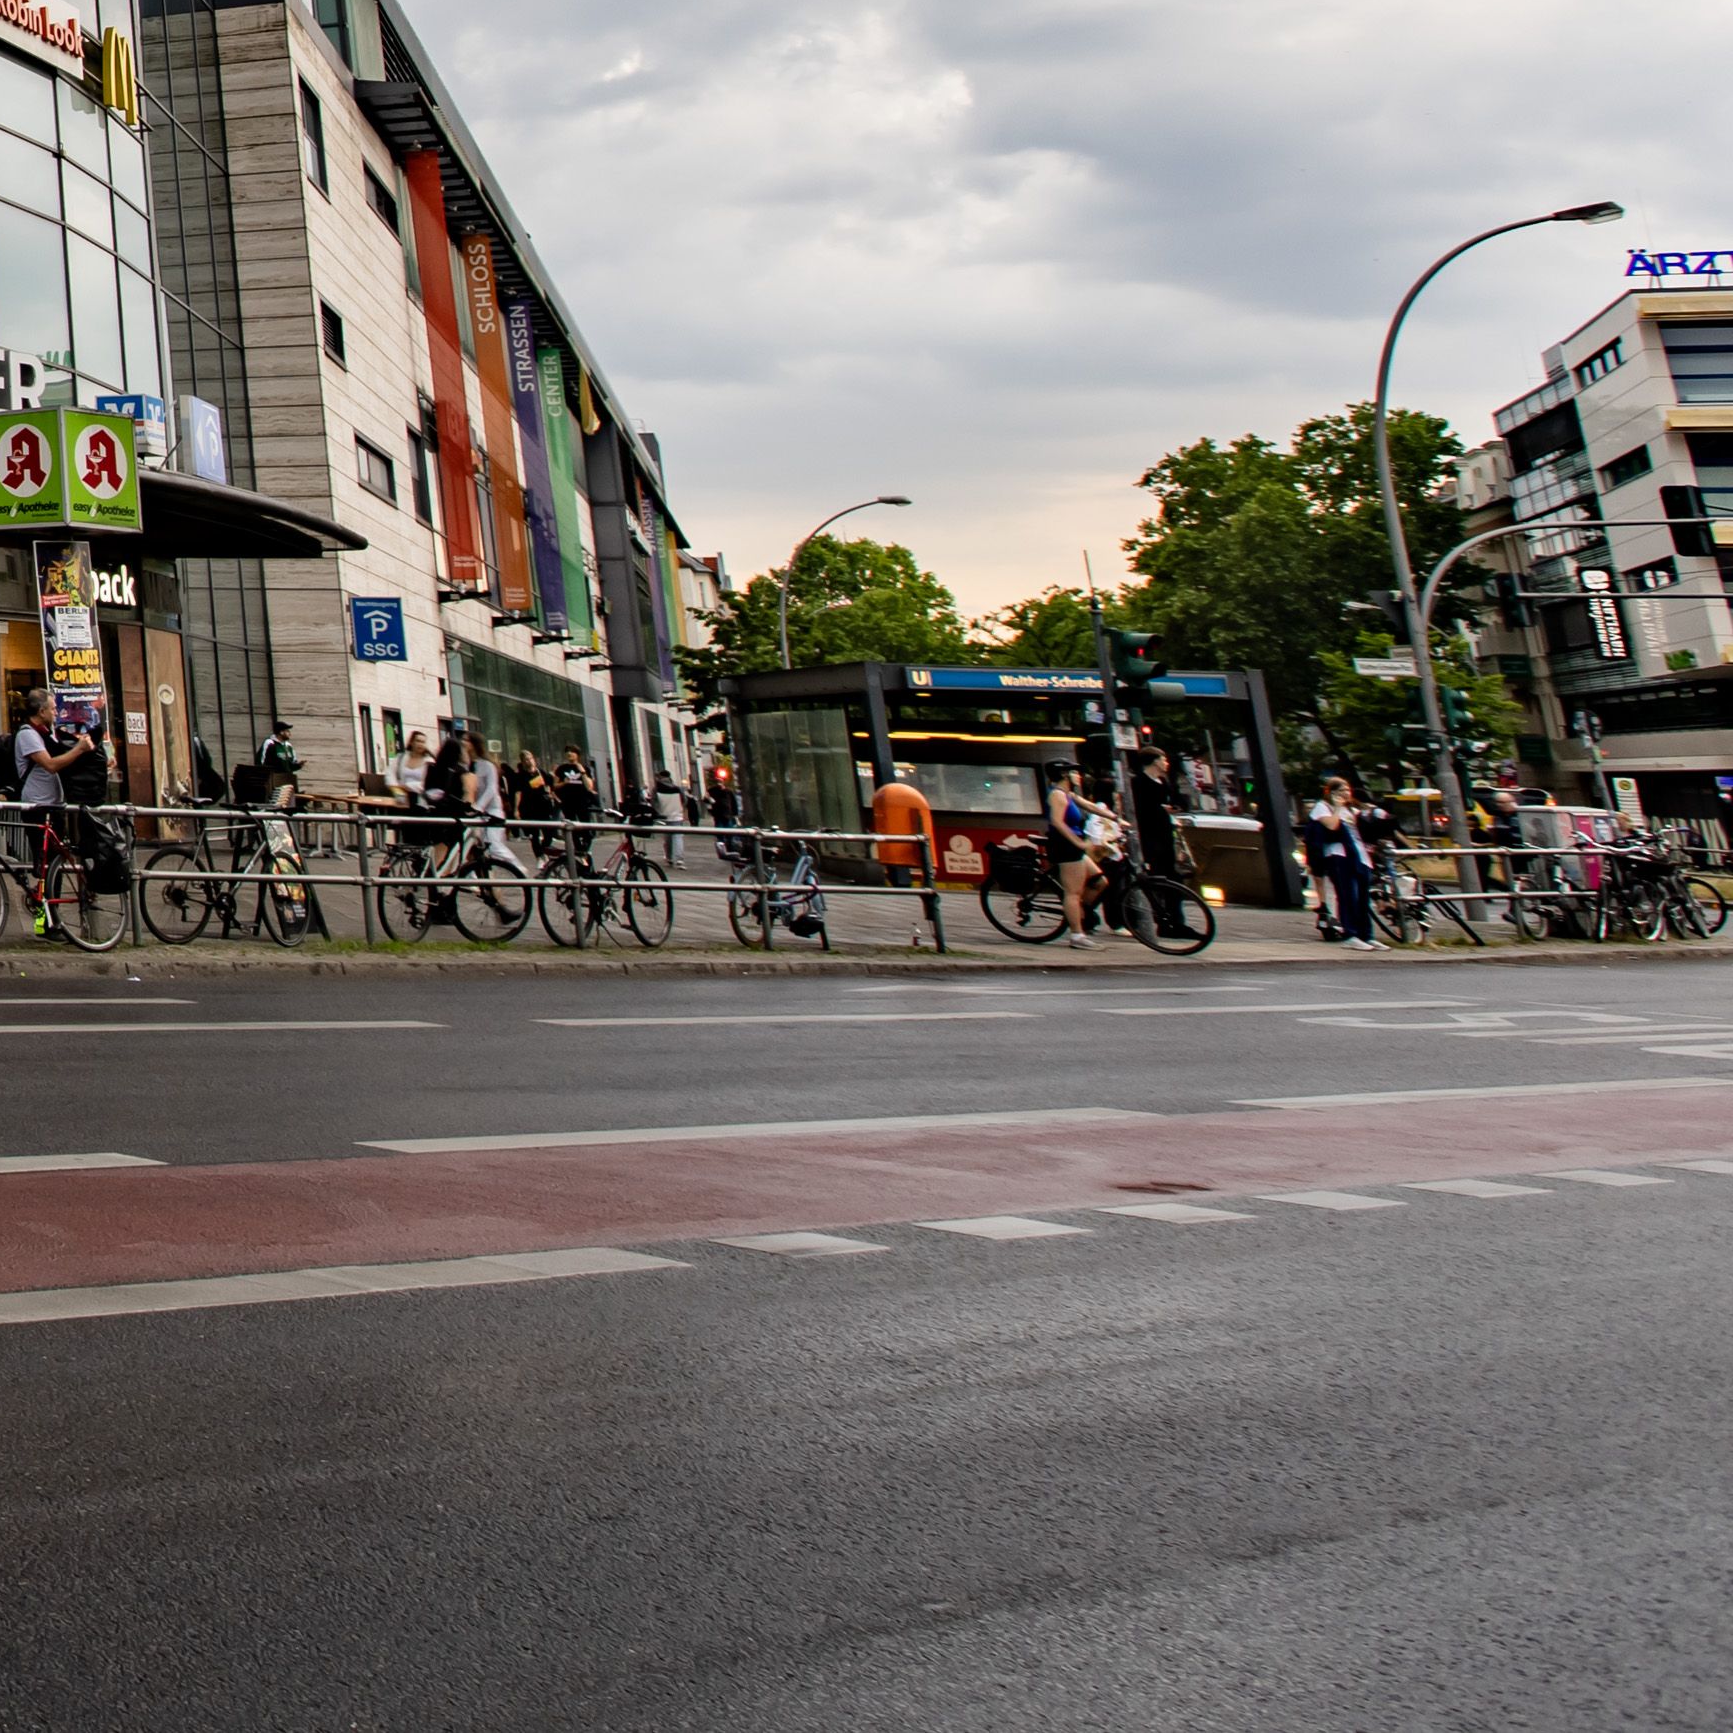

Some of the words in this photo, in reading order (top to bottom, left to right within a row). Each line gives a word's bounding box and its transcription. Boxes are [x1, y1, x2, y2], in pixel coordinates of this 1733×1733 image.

[41, 6, 84, 58] Look
[467, 242, 496, 333] SCHLOSS
[509, 304, 536, 393] STRASSEN
[545, 353, 562, 418] CENTER
[57, 607, 88, 615] BERLIN
[54, 650, 100, 667] GIANTS
[363, 643, 400, 657] SSC
[69, 668, 101, 684] IRON
[999, 674, 1105, 689] Walther-Schreibe
